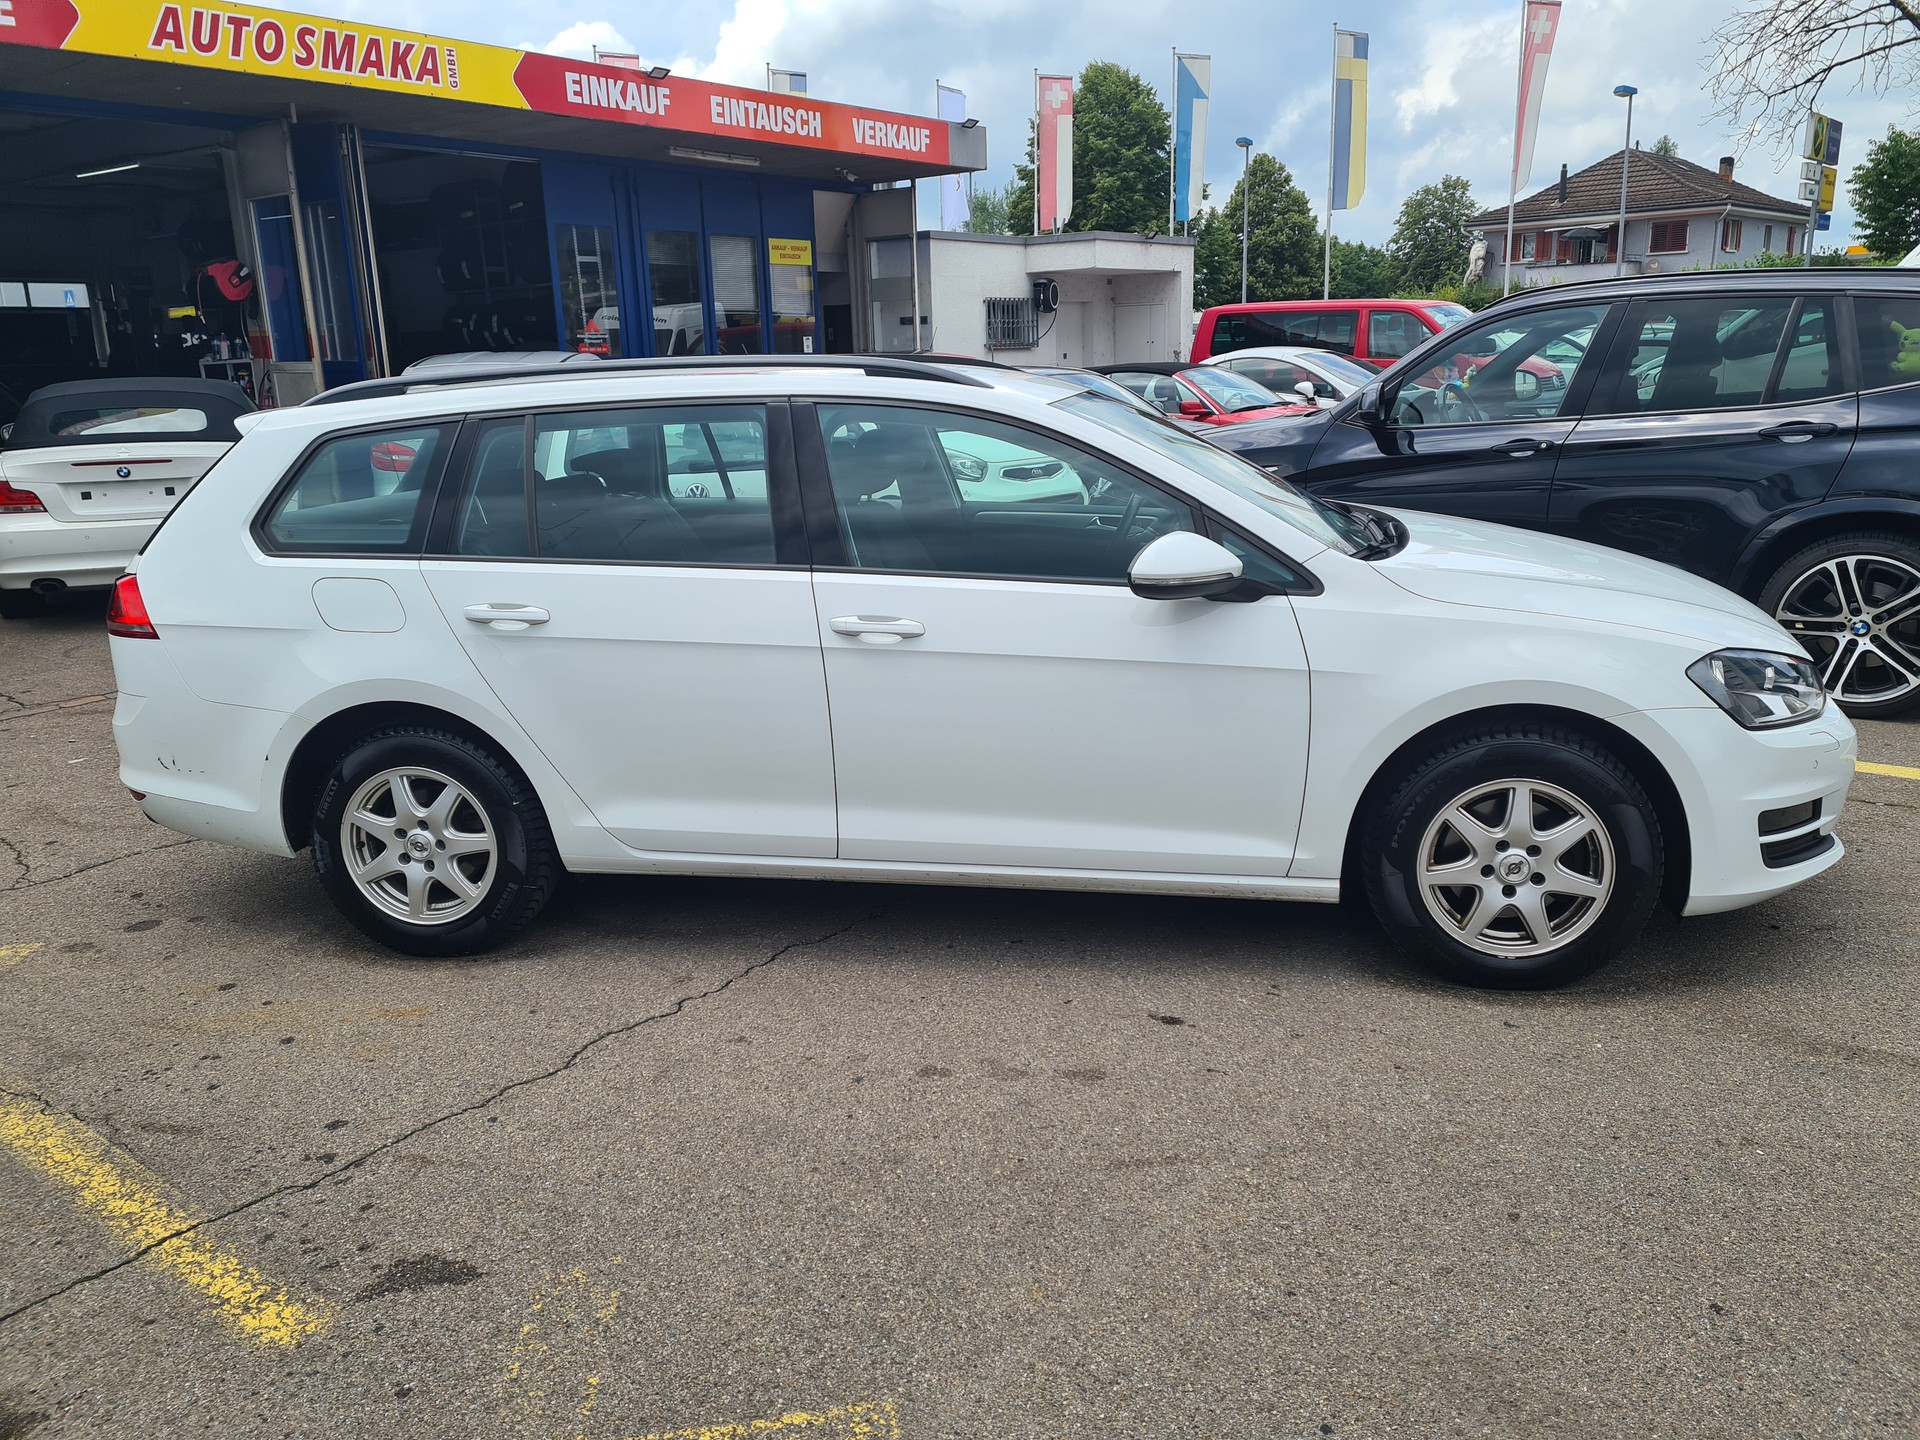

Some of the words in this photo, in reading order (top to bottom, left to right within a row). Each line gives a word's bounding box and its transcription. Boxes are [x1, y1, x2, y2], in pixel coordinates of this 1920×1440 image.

[149, 3, 285, 64] AUTO
[293, 25, 443, 87] SMAKA
[445, 47, 460, 90] GMBH
[564, 71, 671, 116] EINKAUF
[709, 95, 822, 138] EINTAUSCH
[852, 117, 930, 153] VERKAUF
